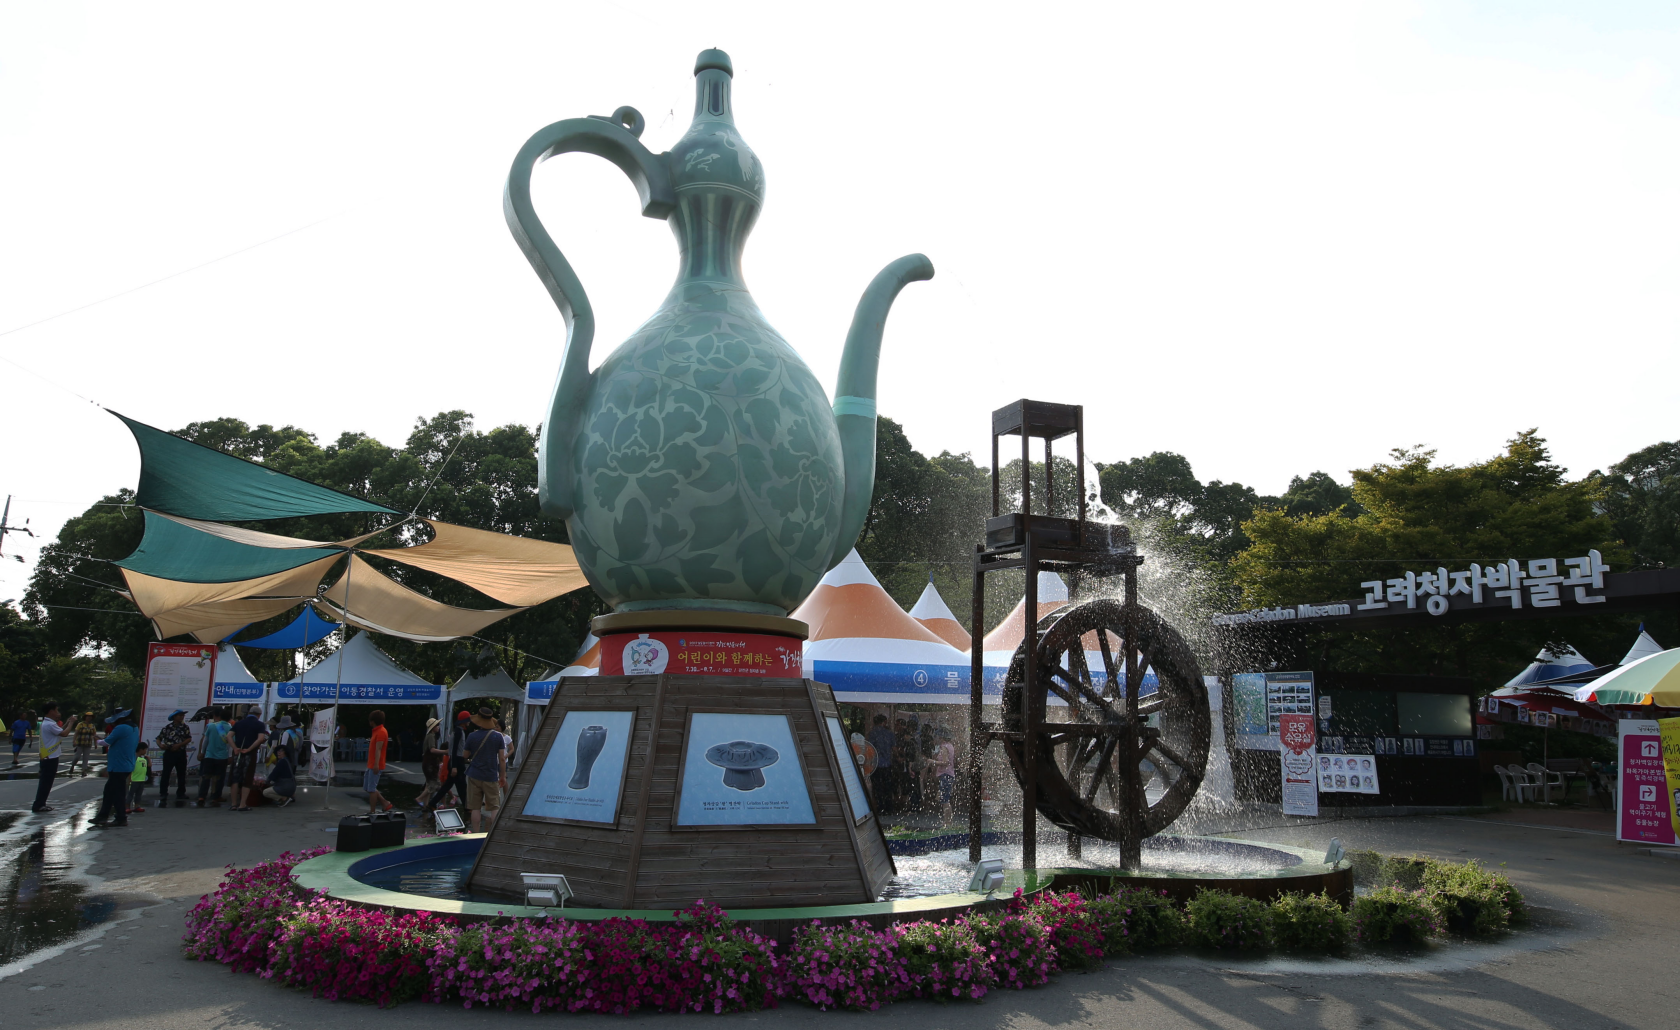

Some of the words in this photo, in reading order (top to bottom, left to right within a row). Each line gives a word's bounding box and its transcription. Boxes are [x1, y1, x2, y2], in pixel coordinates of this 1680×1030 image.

[1356, 549, 1610, 616] 고려청자박물관
[1250, 607, 1296, 622] Celadon
[1298, 604, 1351, 618] Museum
[678, 651, 727, 664] 어린이와
[731, 652, 773, 666] 함께하는
[303, 686, 337, 696] 찾아가는
[342, 686, 384, 697] 이동경찰서
[387, 687, 404, 697] 운영
[1289, 722, 1306, 732] 모유
[1285, 733, 1311, 743] 수유실
